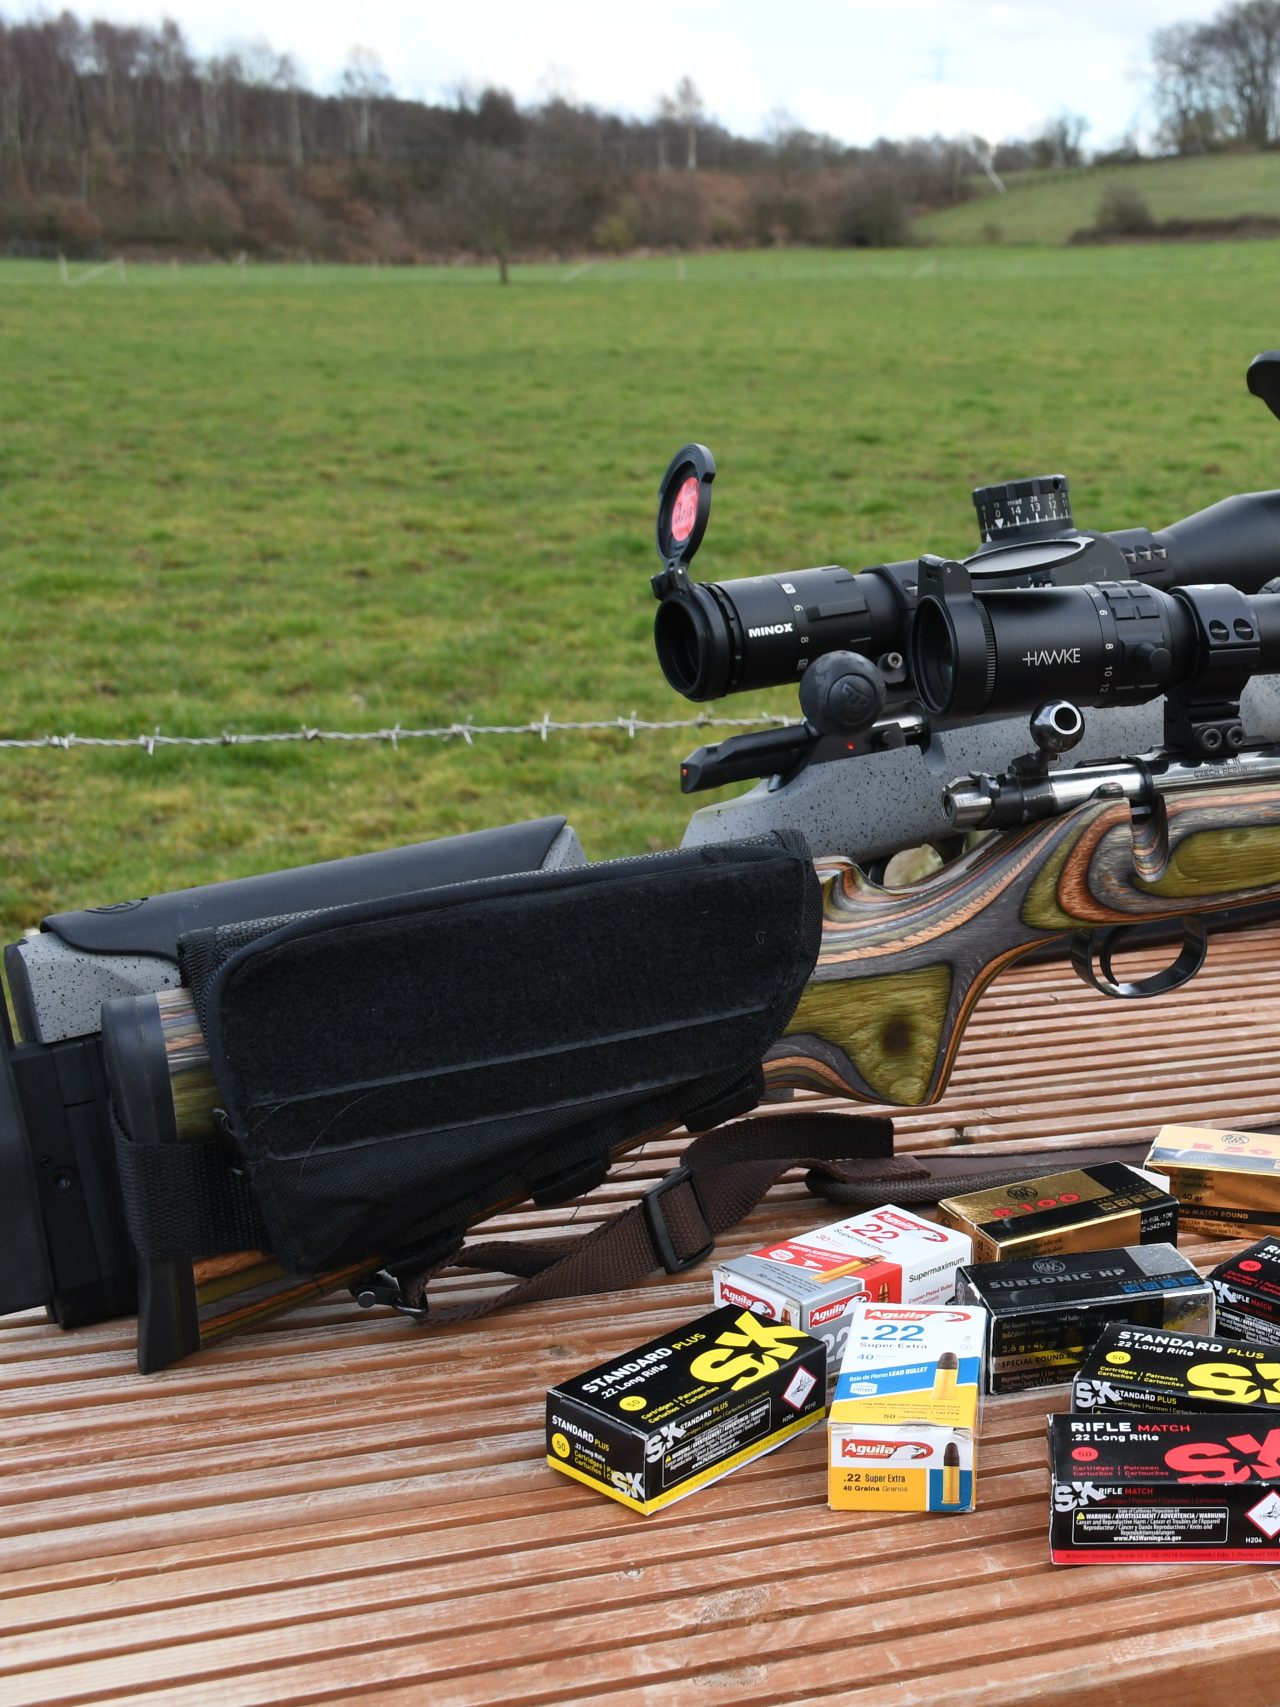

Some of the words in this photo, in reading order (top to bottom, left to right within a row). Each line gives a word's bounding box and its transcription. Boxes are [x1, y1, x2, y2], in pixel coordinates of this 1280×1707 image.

[1011, 506, 1021, 515] 14
[1030, 503, 1040, 512] 13
[1049, 501, 1057, 509] 12
[995, 510, 1000, 518] 0
[749, 623, 793, 638] MINOX
[1022, 648, 1080, 667] HAWKE
[1104, 666, 1113, 676] 10
[1193, 769, 1220, 777] CZECH
[1221, 1211, 1248, 1219] ROUND
[843, 1224, 899, 1244] .22
[909, 1256, 965, 1283] Supermaximum
[989, 1272, 1092, 1289] SUBSONIC
[1100, 1268, 1126, 1277] HP
[722, 1287, 752, 1307] Aguila
[1232, 1292, 1250, 1303] RIFLE
[811, 1303, 845, 1324] Aguila
[861, 1325, 925, 1341] .22
[689, 1310, 810, 1392] SK
[1118, 1331, 1223, 1352] STANDARD
[1227, 1348, 1265, 1359] PLUS
[1135, 1341, 1163, 1353] Long
[1167, 1347, 1195, 1357] Rifle
[582, 1348, 673, 1393] STANDARD
[672, 1333, 706, 1350] PLUS
[889, 1369, 904, 1377] LEAD
[905, 1366, 928, 1375] BULLET
[1099, 1366, 1138, 1375] Cartridges
[1145, 1372, 1178, 1382] Patronen
[601, 1388, 618, 1399] .22
[615, 1376, 645, 1390] Long
[641, 1364, 668, 1378] Rifle
[1076, 1379, 1123, 1408] SK
[1115, 1389, 1156, 1402] STANDARD
[1157, 1395, 1177, 1404] PLUS
[680, 1410, 712, 1430] STANDARD
[713, 1401, 729, 1413] PLUS
[552, 1415, 594, 1443] STANDARD
[594, 1438, 609, 1452] PLUS
[1071, 1422, 1131, 1432] RIFLE
[556, 1440, 566, 1451] 50
[646, 1421, 687, 1463] SK
[1094, 1434, 1126, 1442] Long
[844, 1443, 895, 1456] Aguila
[574, 1450, 602, 1469] Cartridges
[611, 1471, 645, 1499] SK
[843, 1474, 861, 1482] .22
[865, 1474, 885, 1484] Super
[887, 1474, 905, 1483] Extra
[1054, 1481, 1108, 1512] SK
